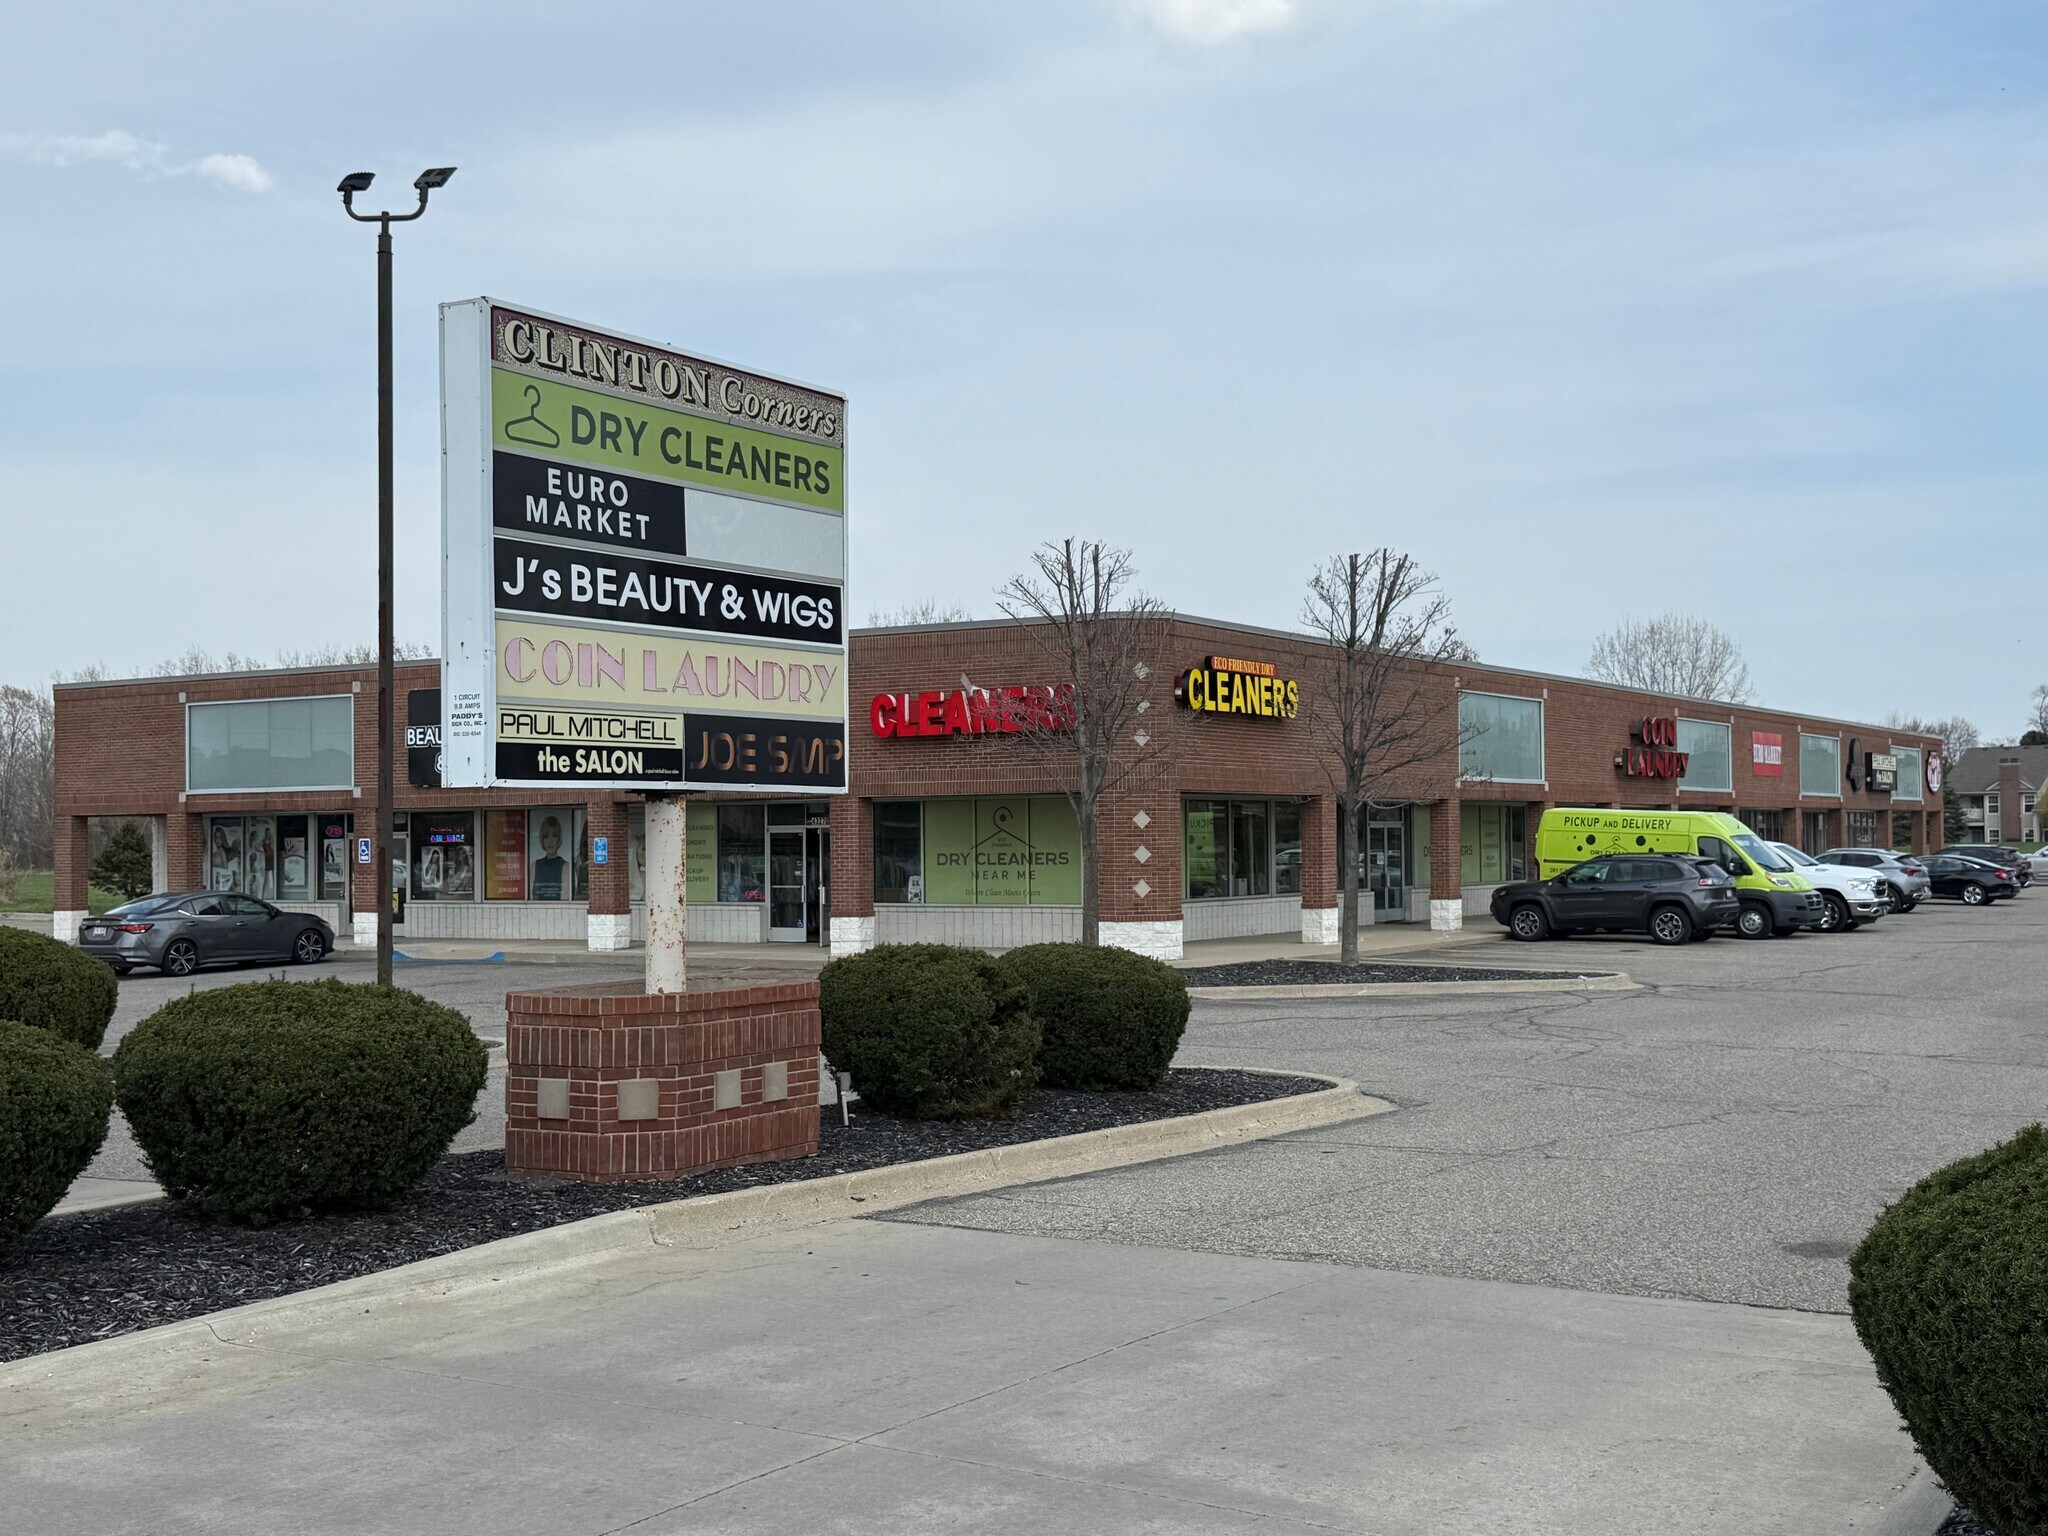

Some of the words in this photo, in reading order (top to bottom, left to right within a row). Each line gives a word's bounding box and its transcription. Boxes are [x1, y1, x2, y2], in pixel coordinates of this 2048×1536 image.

[504, 317, 710, 408] CLINTON
[719, 376, 836, 437] Corners
[571, 404, 649, 457] DRY
[660, 427, 830, 495] CLEANERS
[547, 468, 629, 507] EURO
[526, 495, 651, 541] MARKET
[502, 557, 562, 600] J's
[571, 563, 712, 617] BEAUTY
[721, 584, 747, 621] &
[752, 588, 834, 630] WIGS
[504, 636, 626, 692] COIN
[643, 648, 838, 704] LAUNDRY
[1213, 656, 1227, 669] ECO
[1229, 658, 1259, 675] FRIENDLY
[1261, 664, 1275, 676] DRY
[458, 693, 481, 701] CIRCUIT
[1188, 668, 1299, 719] CLEANERS
[451, 712, 483, 720] PADDY'S
[500, 712, 565, 737] PAUL
[568, 716, 676, 742] MITCHELL
[538, 746, 571, 773] the
[575, 748, 643, 775] SALON
[690, 731, 757, 773] JOE
[1628, 749, 1690, 778] LAUNDRY
[1564, 816, 1600, 828] PICKUP
[1603, 820, 1618, 828] AND
[1621, 818, 1672, 830] DELIVERY
[936, 852, 971, 867] DRY
[975, 852, 1070, 866] CLEANERS
[971, 870, 1009, 880] NEAR
[1017, 870, 1036, 880] ME
